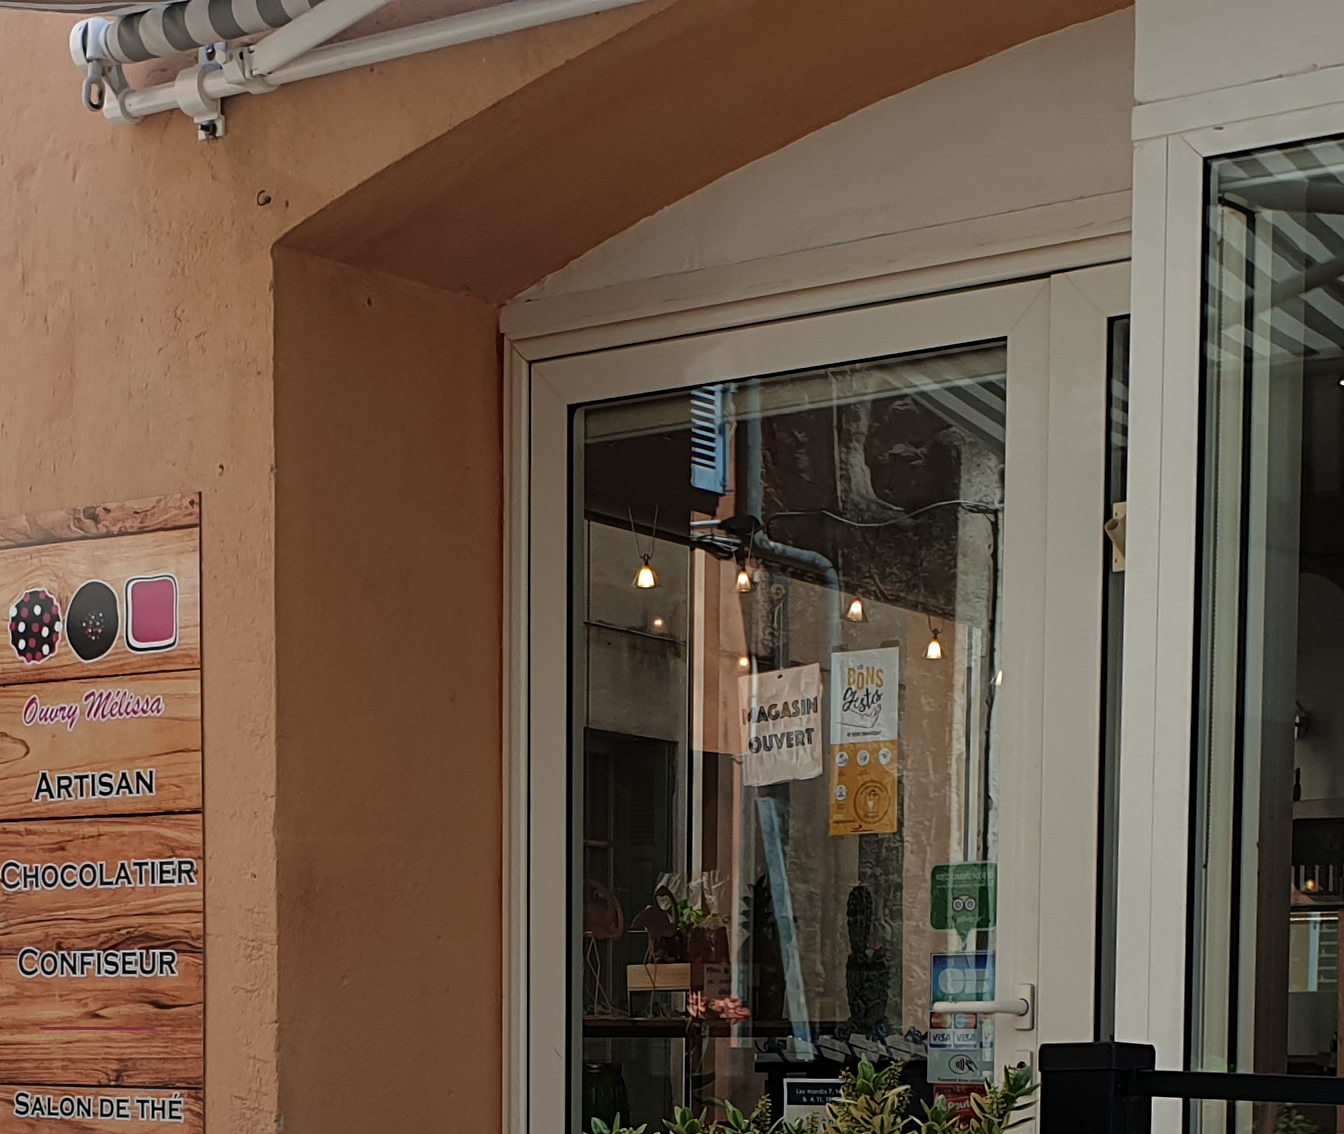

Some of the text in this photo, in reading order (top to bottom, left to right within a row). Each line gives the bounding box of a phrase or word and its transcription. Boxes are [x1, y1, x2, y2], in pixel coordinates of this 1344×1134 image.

[847, 666, 884, 690] BONS
[23, 689, 164, 730] Ouvry Mélissa
[742, 696, 818, 725] MAGASIN
[748, 727, 815, 754] OUVERT
[33, 769, 155, 801] ARTISAN
[0, 859, 197, 890] CHOCOLATIER
[17, 946, 178, 978] CONFISEUR
[933, 1033, 951, 1042] VISA
[14, 1091, 184, 1121] SALON DE THÉ
